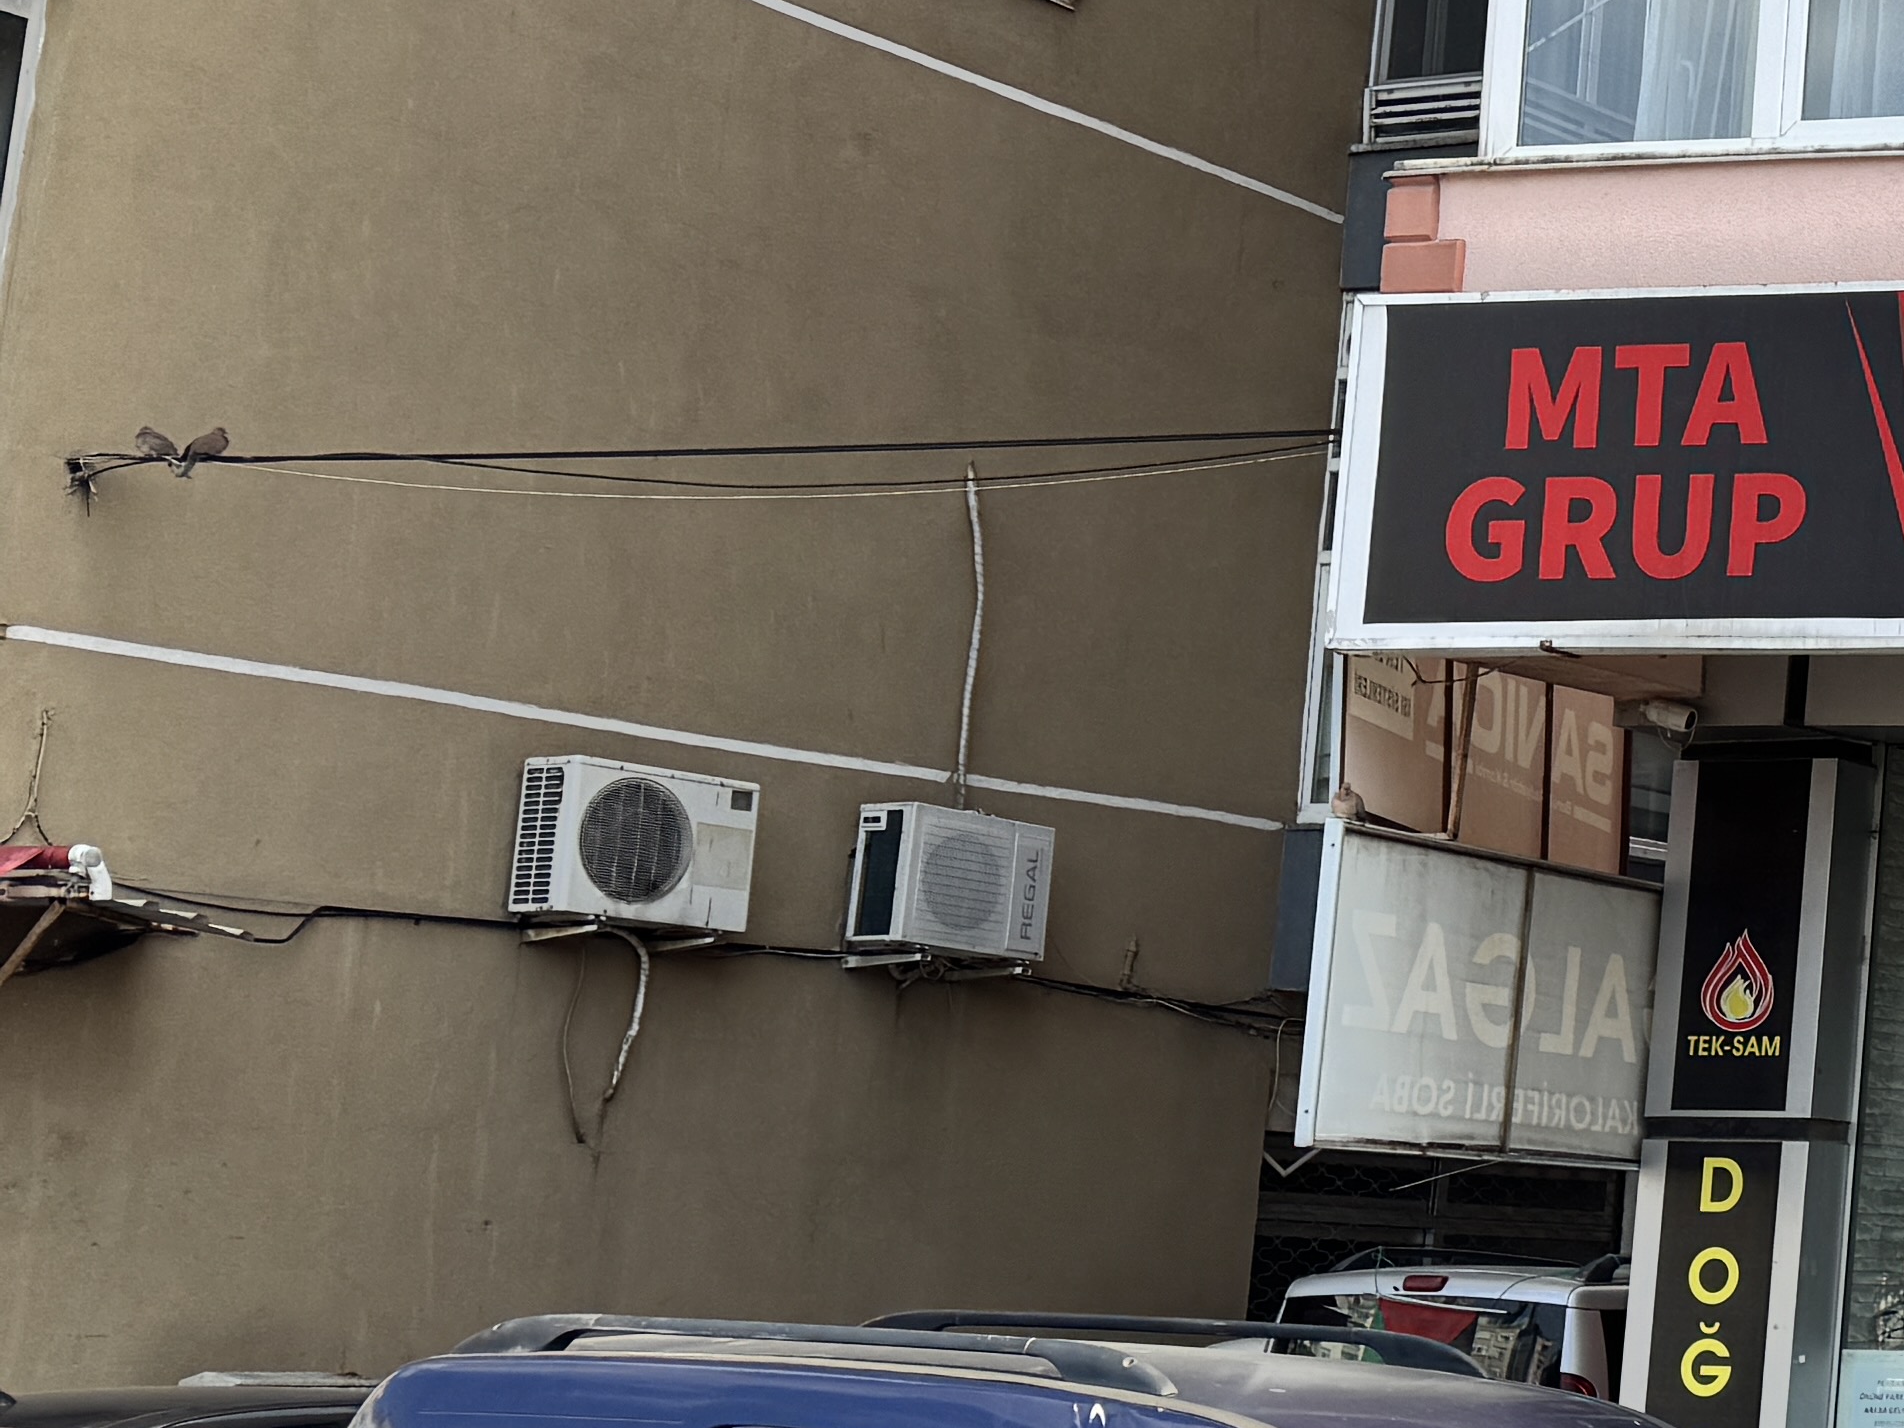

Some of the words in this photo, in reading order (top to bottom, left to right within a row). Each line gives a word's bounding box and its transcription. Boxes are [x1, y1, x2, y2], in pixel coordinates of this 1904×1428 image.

[1505, 341, 1767, 450] MTA
[1444, 471, 1806, 582] GRUP
[1020, 849, 1041, 940] REGAL
[1687, 1034, 1781, 1058] TEK-SAM
